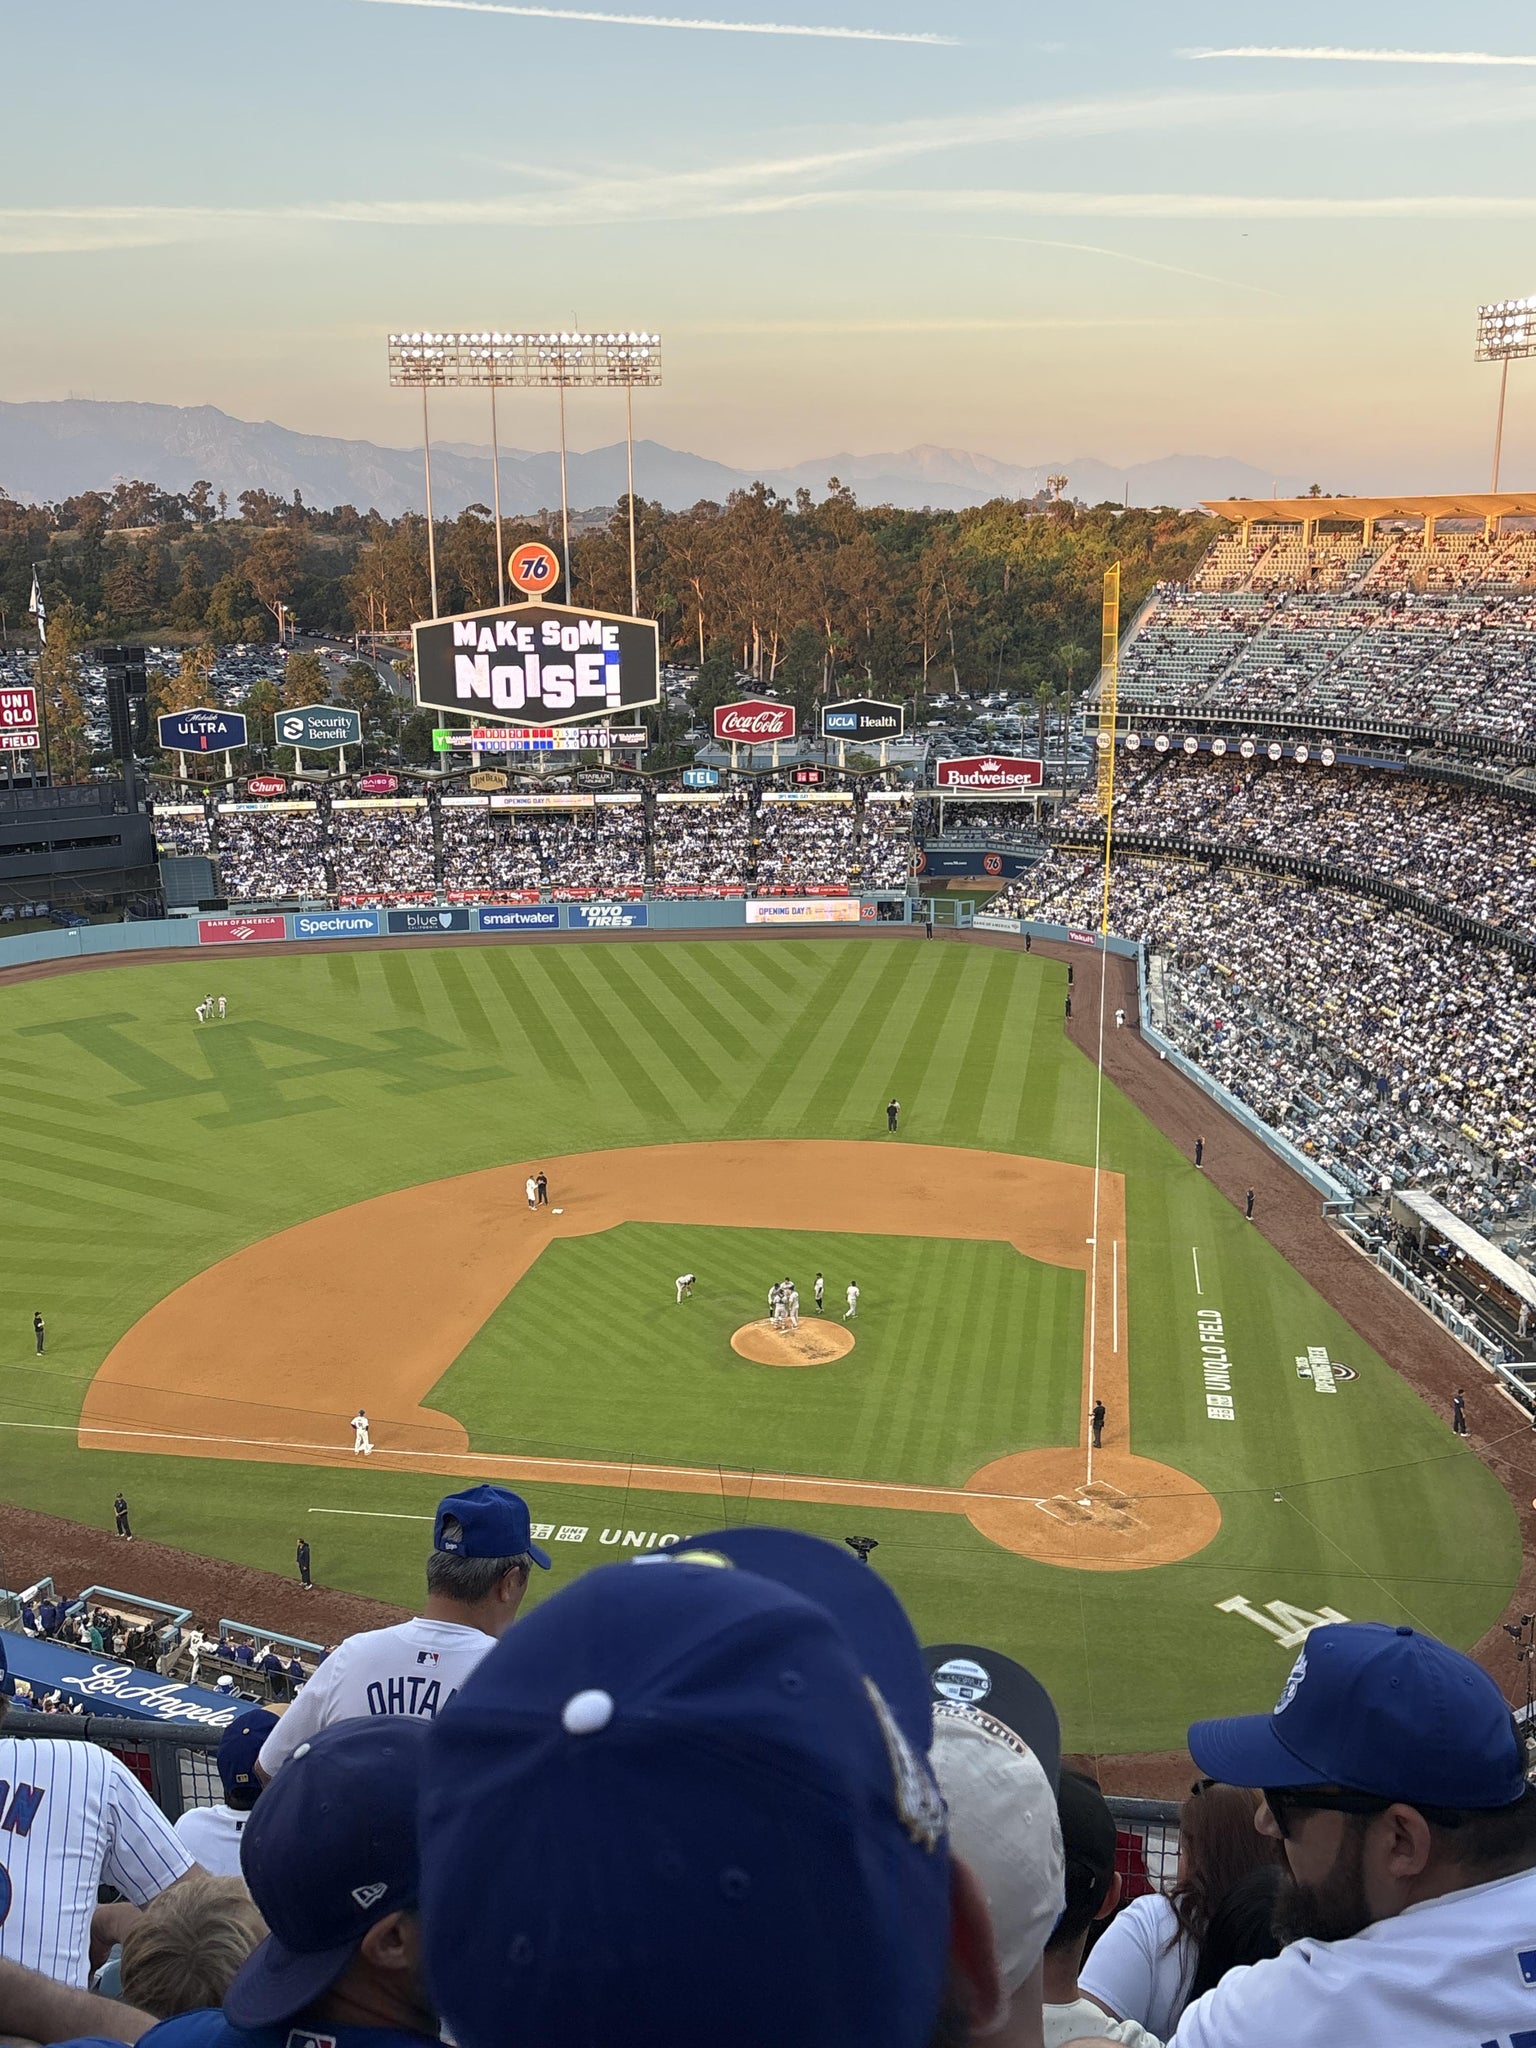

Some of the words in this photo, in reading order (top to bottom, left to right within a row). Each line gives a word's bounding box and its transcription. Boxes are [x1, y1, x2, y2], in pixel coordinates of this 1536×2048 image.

[520, 556, 548, 580] 76
[453, 620, 534, 652] MAKE
[541, 620, 620, 651] SOME
[455, 654, 621, 709] NOISE!
[2, 694, 28, 708] UNI
[3, 709, 32, 724] QLO
[308, 716, 352, 728] Security
[722, 712, 786, 733] Coca-Cola
[828, 716, 854, 727] UCLA
[860, 716, 897, 728] Health
[178, 722, 228, 734] ULTRA
[310, 728, 347, 740] Benefit
[2, 736, 34, 748] FIELD
[474, 776, 485, 786] JIM
[486, 774, 503, 786] BEAM
[687, 772, 714, 784] TEL
[947, 771, 1031, 784] Budweiser
[250, 782, 284, 792] Churu
[986, 857, 999, 870] 76
[580, 906, 623, 916] TOYO
[862, 906, 875, 916] 76
[407, 914, 438, 926] blue
[483, 912, 554, 925] smartwater
[587, 916, 633, 926] TIRES
[300, 918, 369, 934] Spectrum
[1069, 932, 1095, 944] Yakult
[1197, 1310, 1225, 1343] FIELD
[1201, 1346, 1232, 1390] UNIQLO
[1310, 1364, 1337, 1393] OPENING
[62, 1664, 130, 1694] Los
[115, 1683, 234, 1727] Angele
[366, 1676, 458, 1719] OHTA
